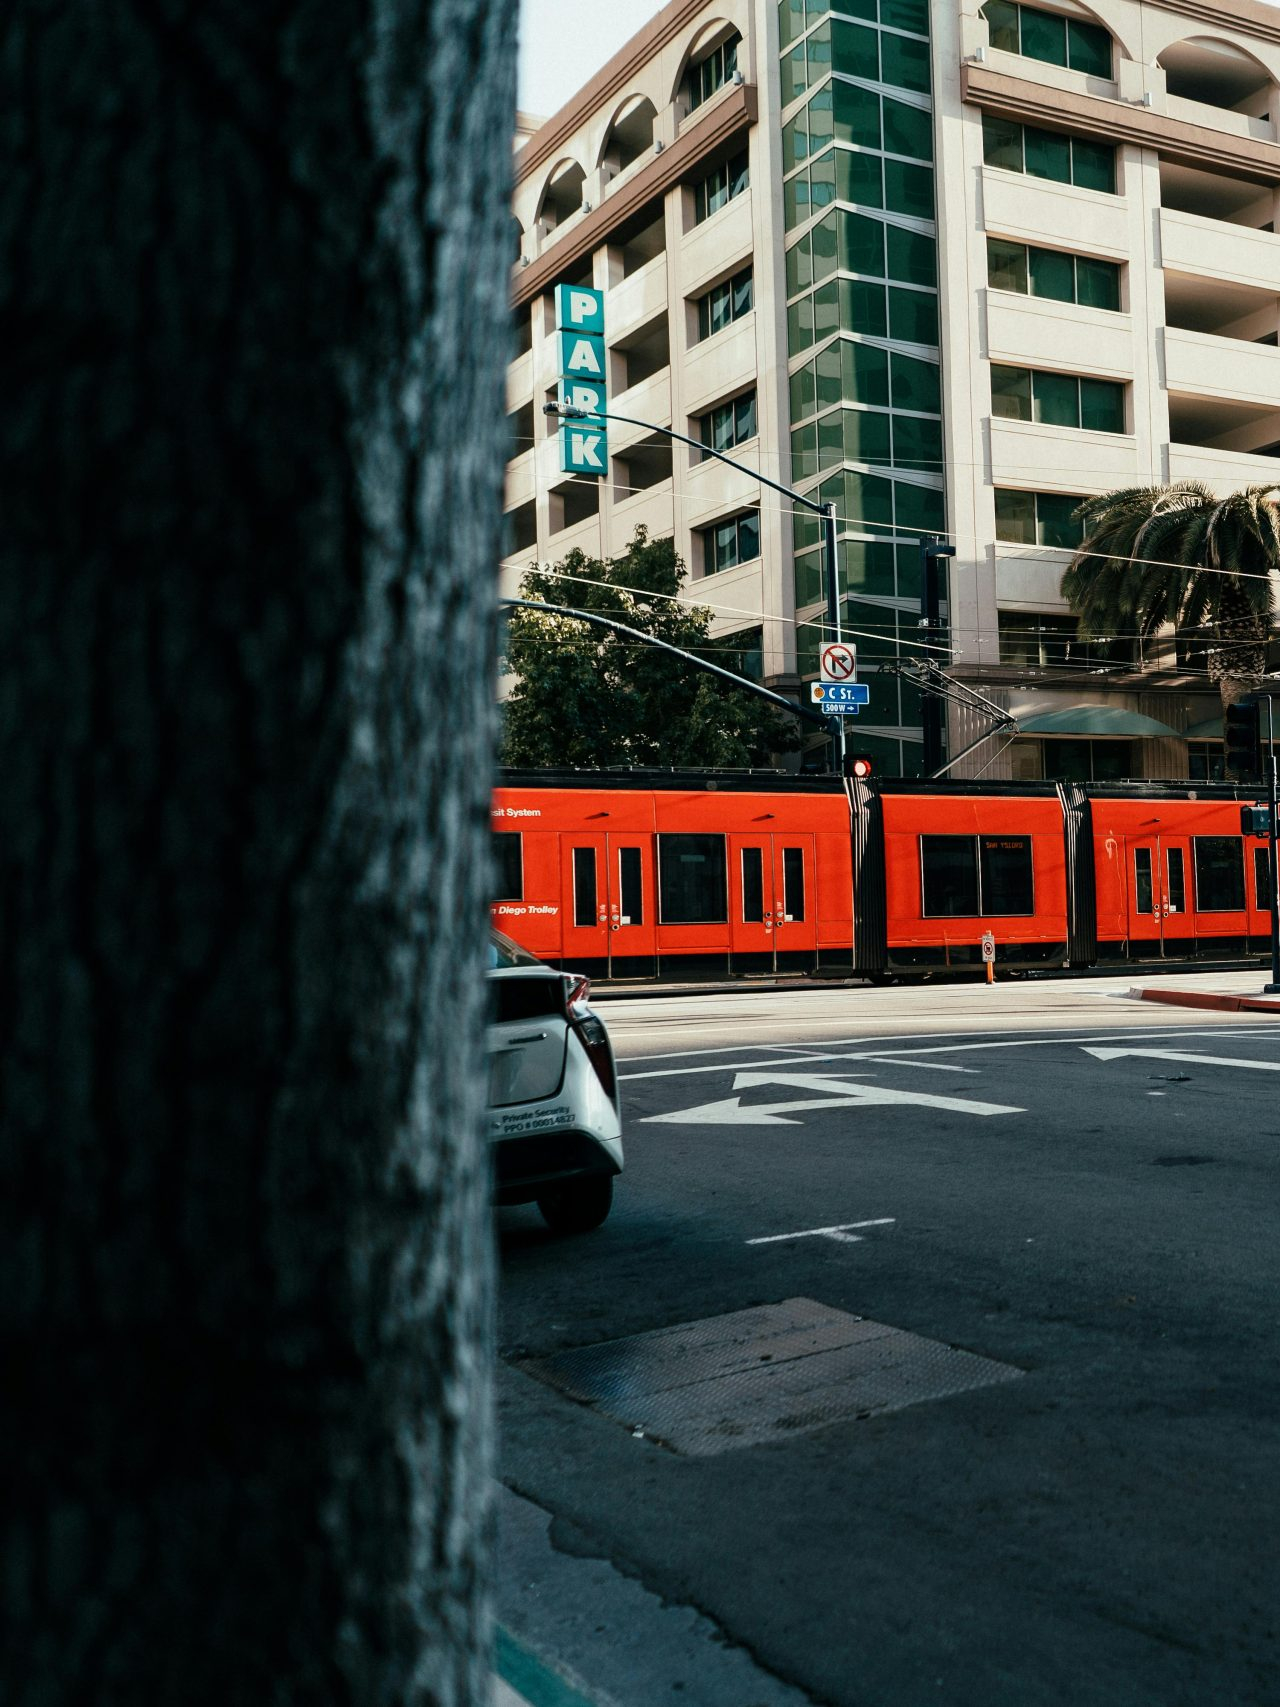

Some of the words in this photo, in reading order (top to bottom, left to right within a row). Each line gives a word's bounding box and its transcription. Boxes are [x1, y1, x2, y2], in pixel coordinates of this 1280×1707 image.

[567, 291, 603, 467] PARK
[828, 687, 836, 700] C
[506, 808, 541, 818] System
[498, 906, 527, 916] Diego
[527, 905, 559, 915] Trolley
[502, 1112, 534, 1123] Private
[534, 1106, 570, 1118] Security
[503, 1123, 524, 1133] PPO
